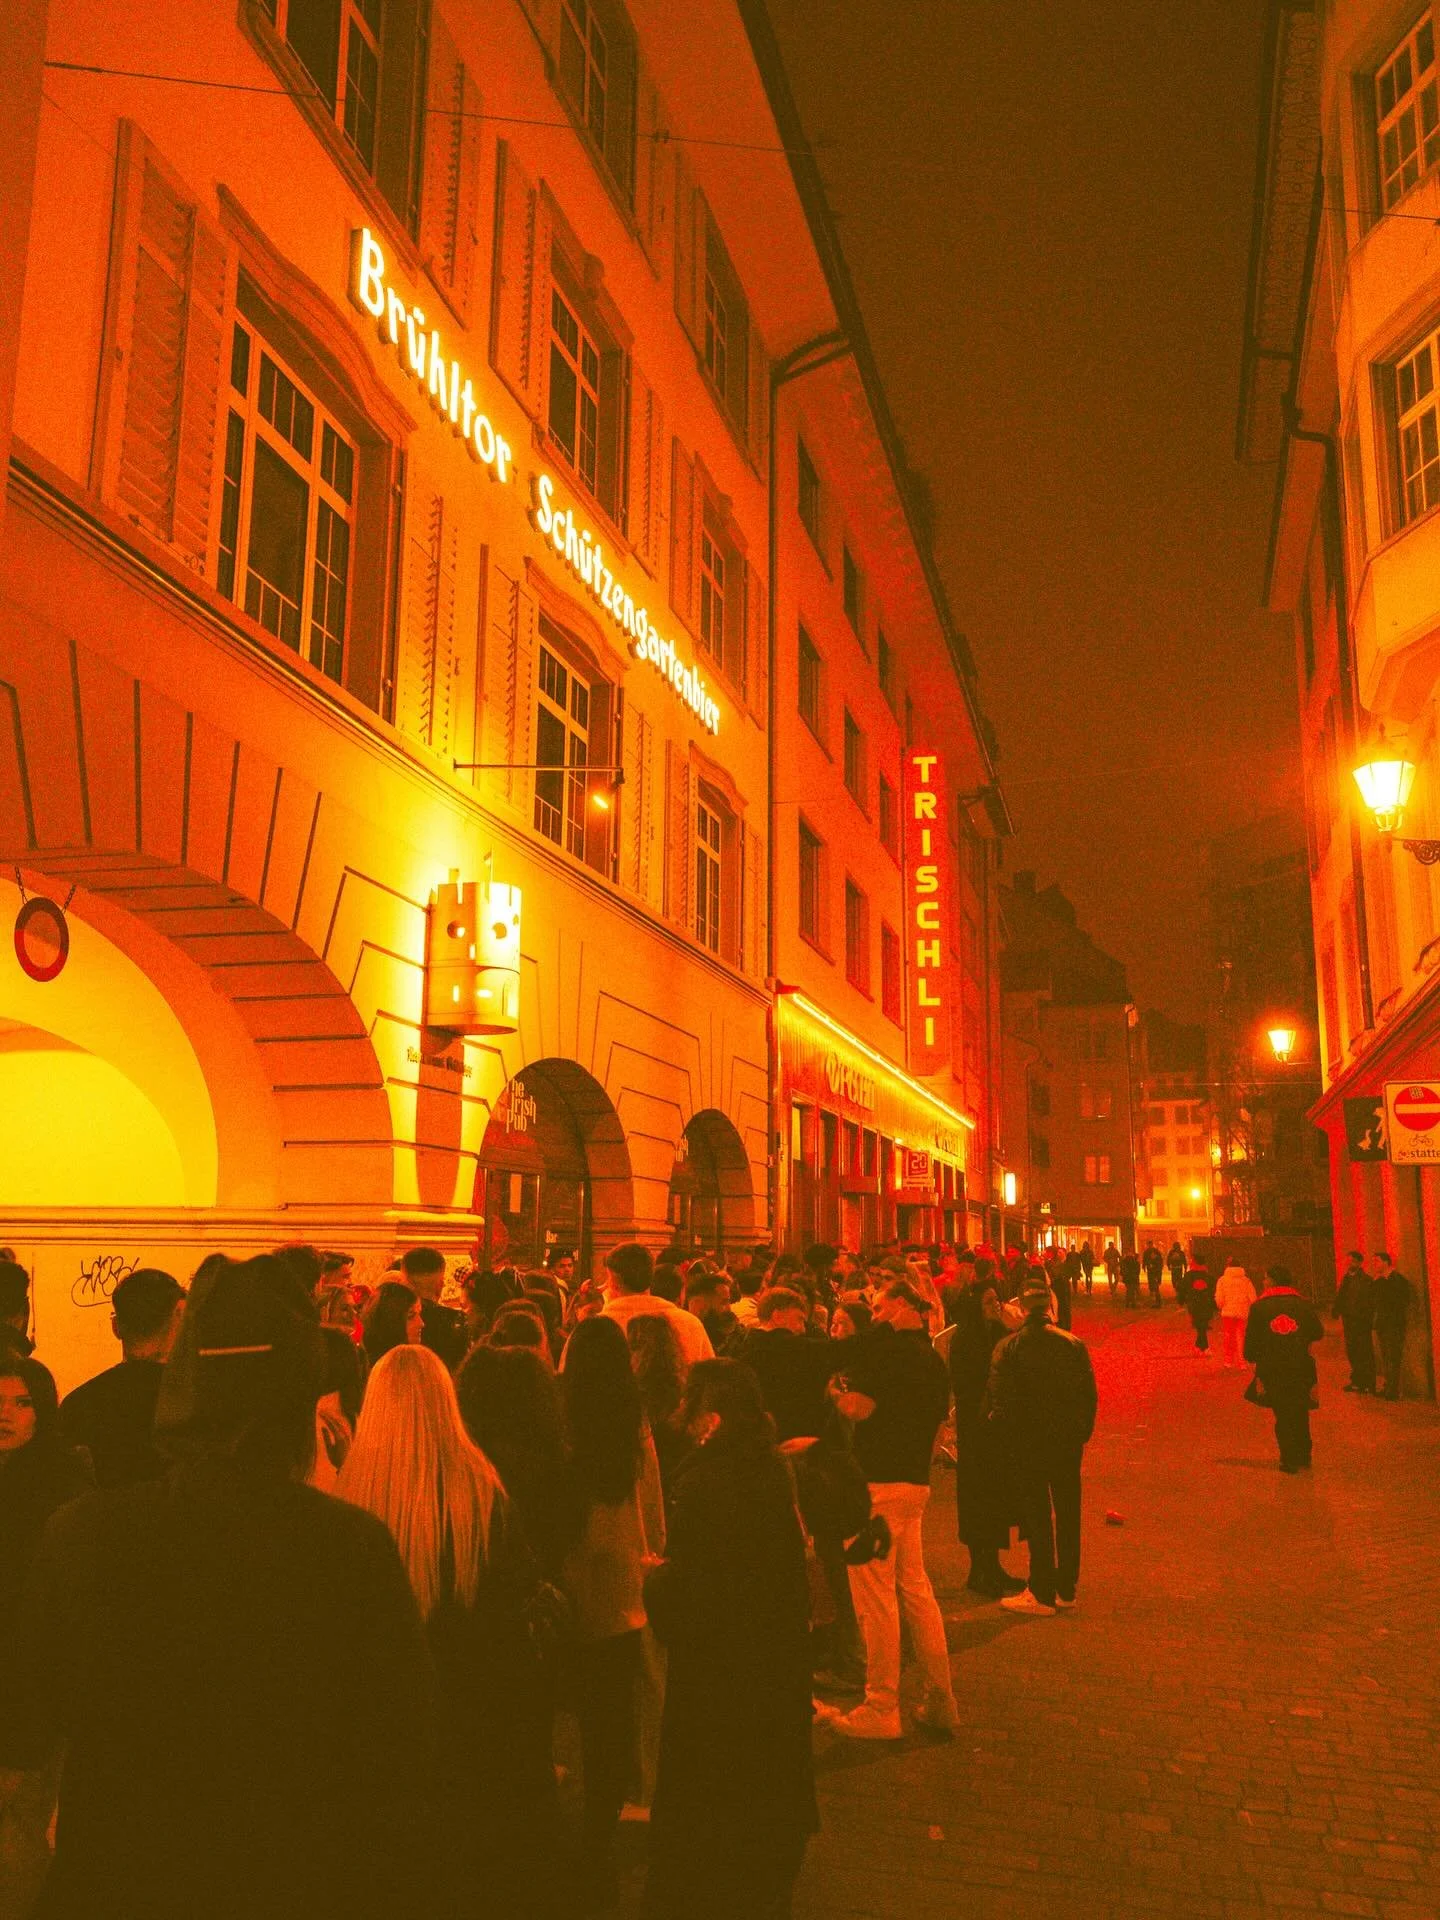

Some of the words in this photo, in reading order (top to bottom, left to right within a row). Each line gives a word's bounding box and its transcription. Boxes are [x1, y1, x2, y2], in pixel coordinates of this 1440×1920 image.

[360, 227, 512, 483] Brühltor
[537, 474, 720, 736] Schützengartenbier
[912, 755, 942, 1046] TRISCHLI
